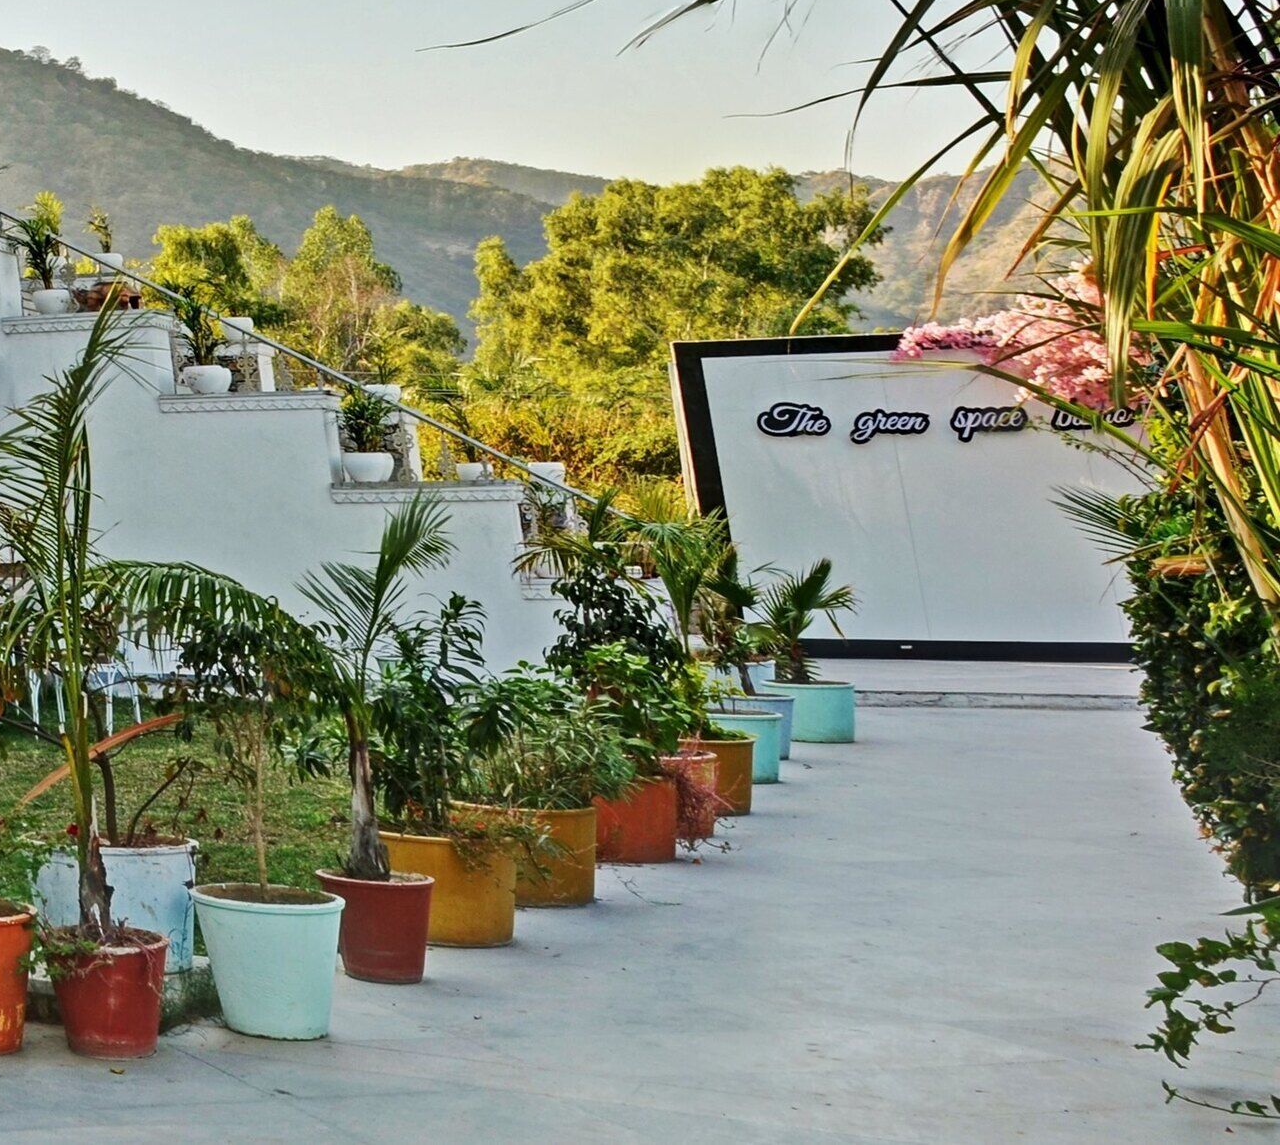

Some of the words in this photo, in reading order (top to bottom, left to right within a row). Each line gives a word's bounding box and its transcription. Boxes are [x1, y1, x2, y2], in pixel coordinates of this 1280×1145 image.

[759, 404, 829, 435] The
[852, 410, 928, 442] green
[953, 408, 1026, 439] space
